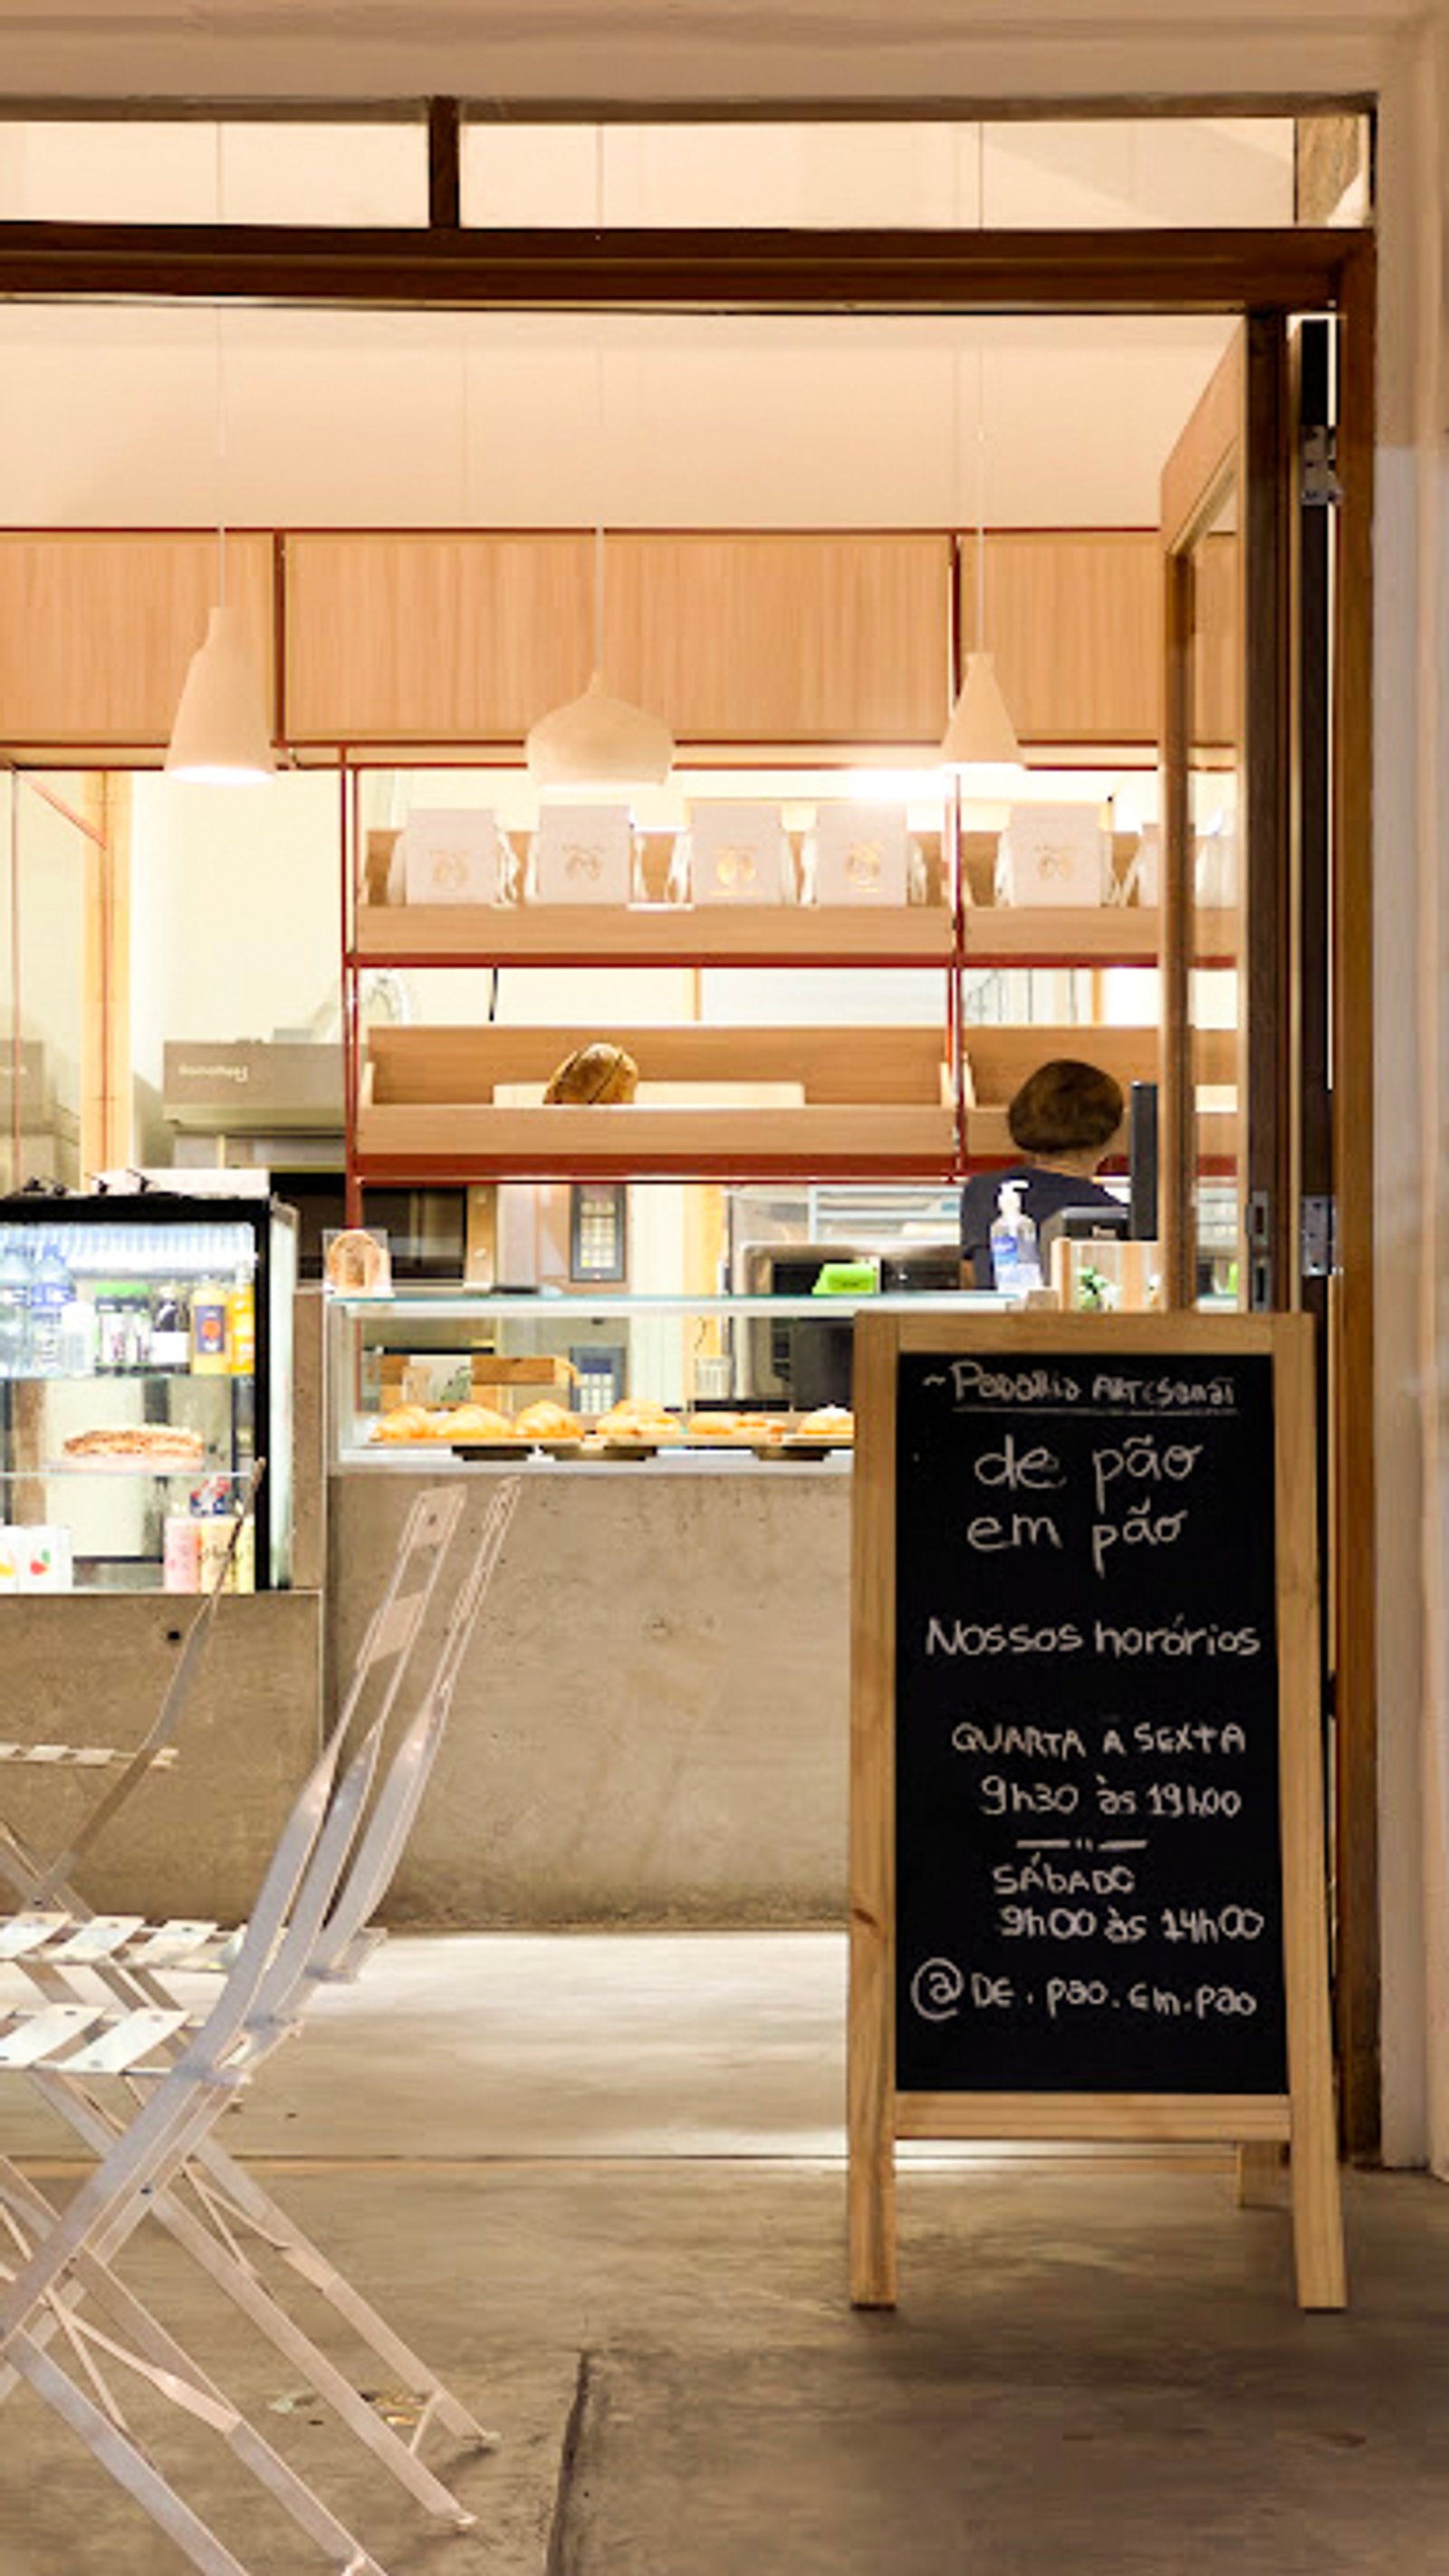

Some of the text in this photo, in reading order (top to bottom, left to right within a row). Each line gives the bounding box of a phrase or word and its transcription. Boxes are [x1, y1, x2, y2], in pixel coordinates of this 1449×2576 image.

[974, 1434, 1204, 1514] de pão
[966, 1496, 1188, 1580] em pão
[925, 1617, 1083, 1657] Nossos
[951, 1722, 1087, 1761] QUARTA
[1102, 1729, 1126, 1756] A
[981, 1773, 1243, 1818] 9h30 às 19h00
[999, 1905, 1265, 1944] 9h00 às 14h00
